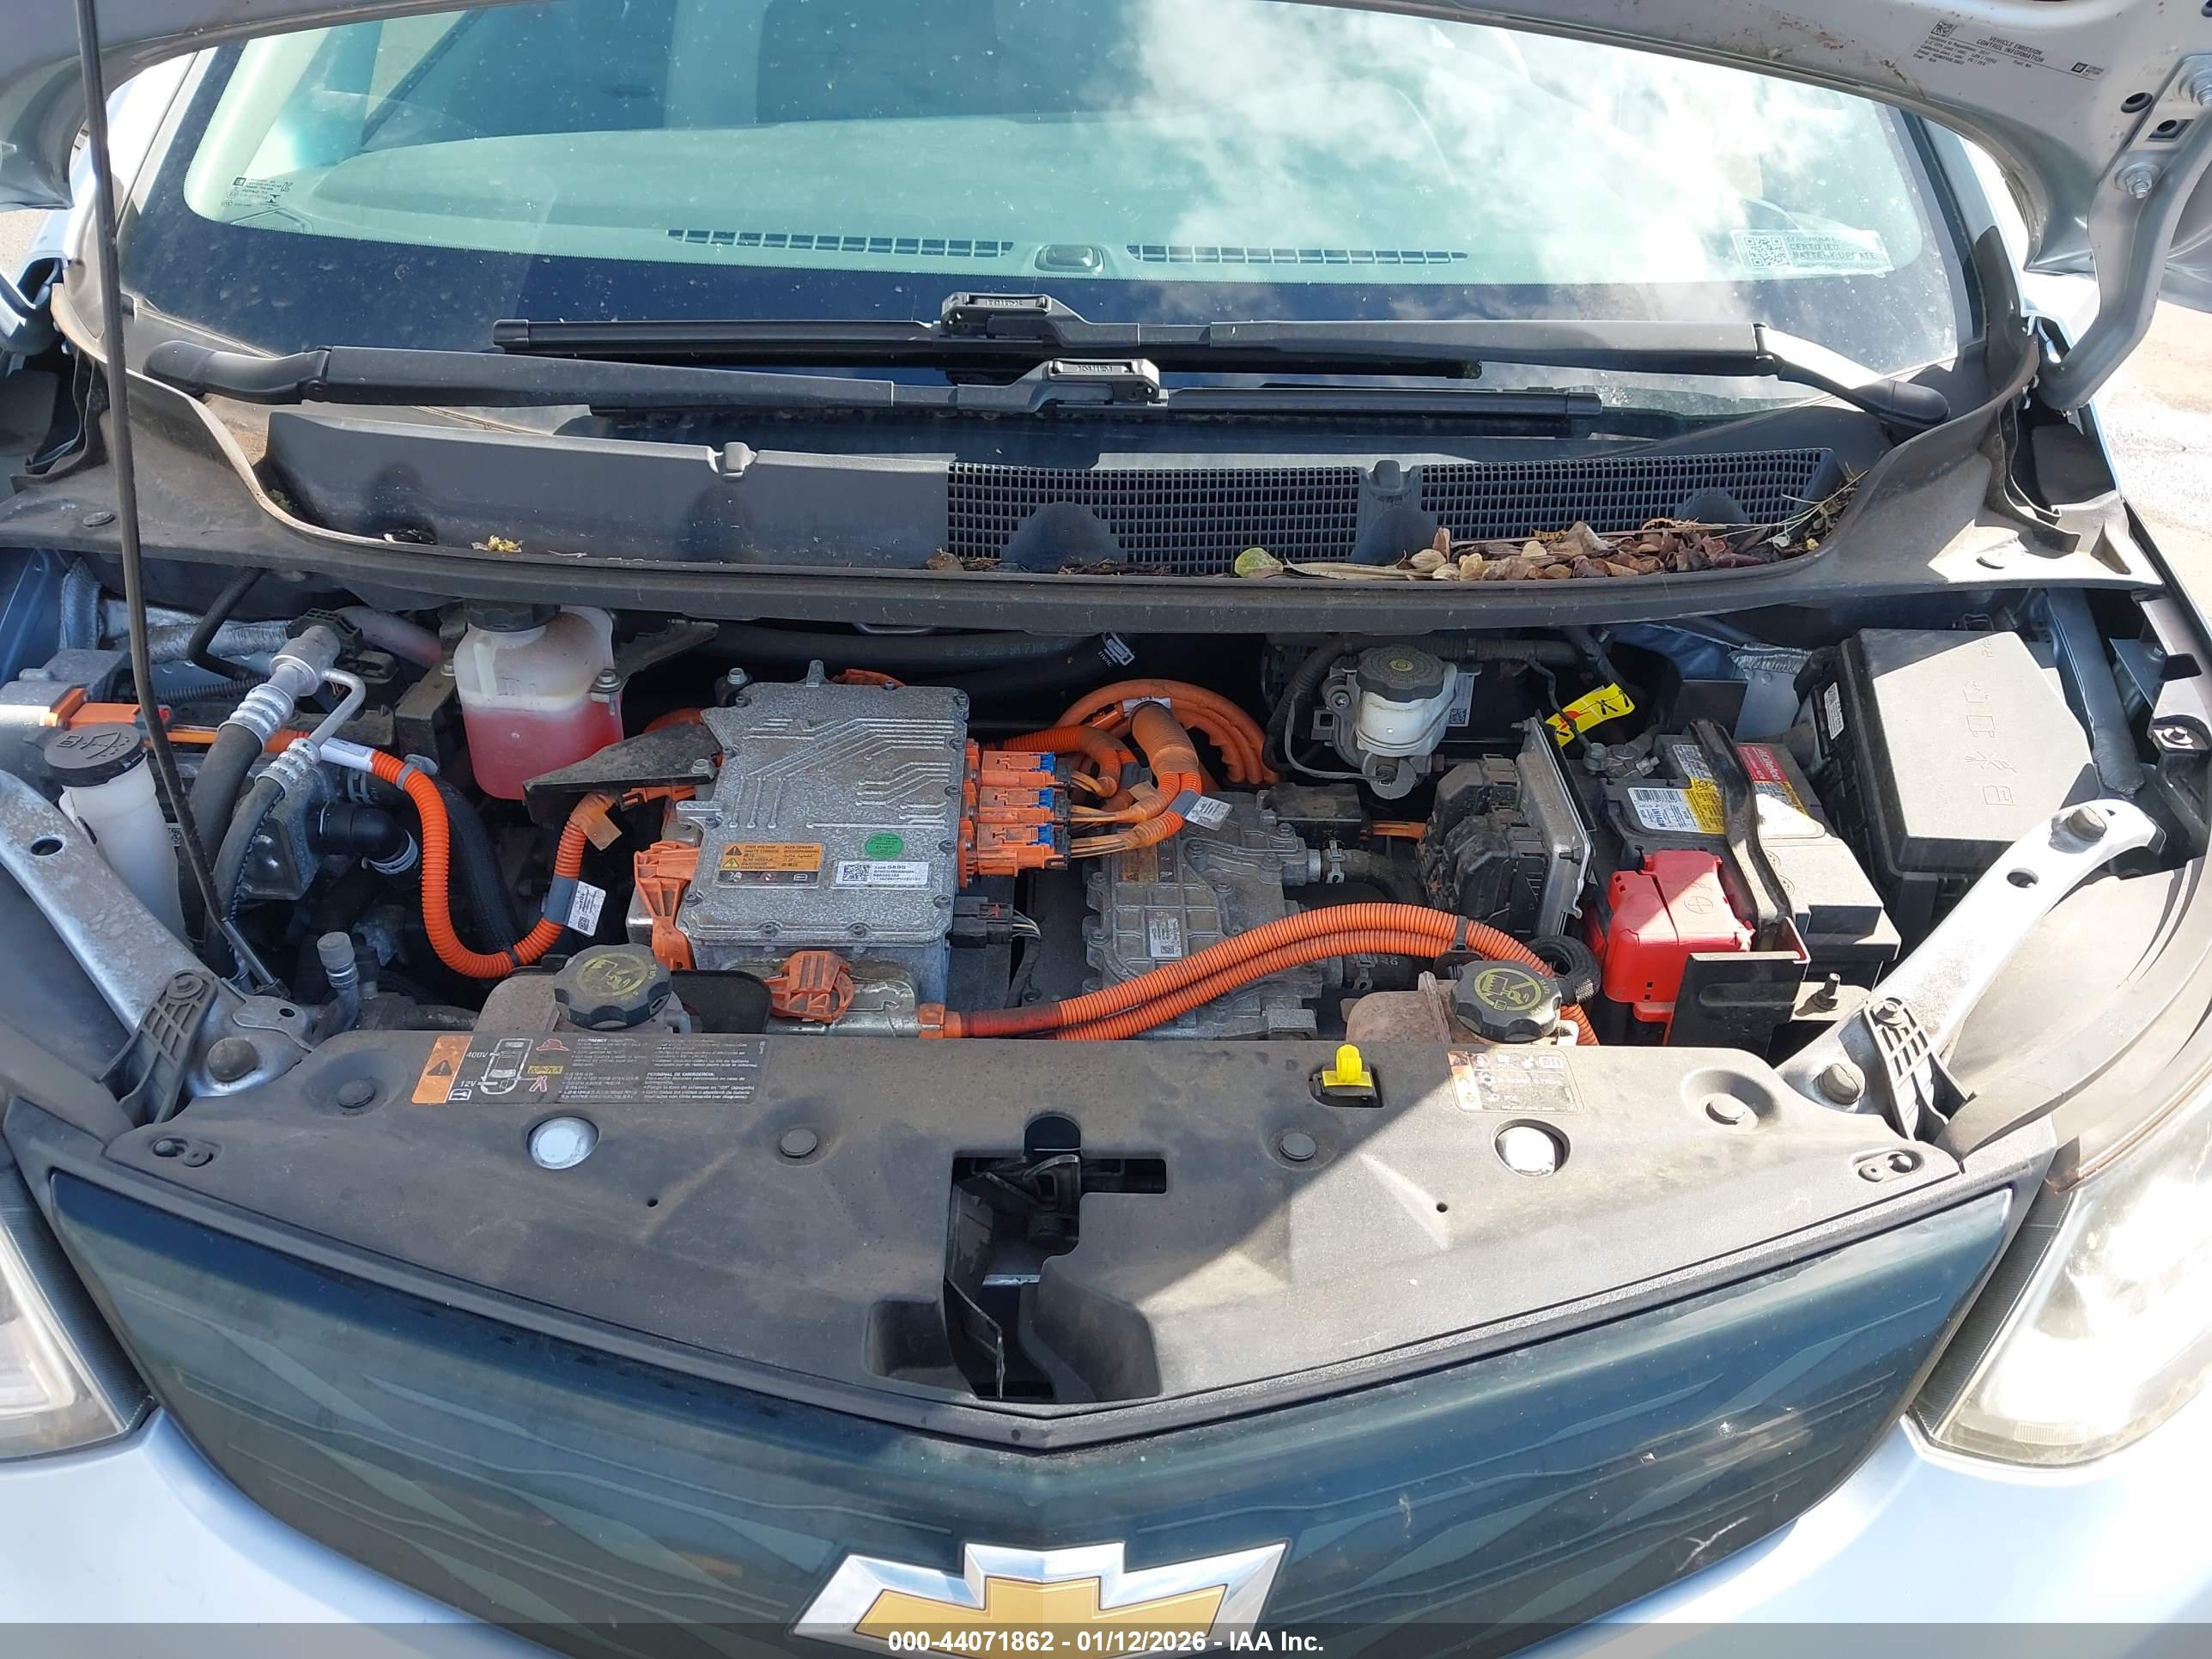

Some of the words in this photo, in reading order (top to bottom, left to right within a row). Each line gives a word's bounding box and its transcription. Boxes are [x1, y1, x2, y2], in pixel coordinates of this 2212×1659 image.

[1977, 39, 2003, 51] CONTROL
[2004, 46, 2045, 63] INFORMATION
[1990, 35, 2014, 47] VEHICLE
[2014, 41, 2043, 56] EMISSION
[1793, 252, 1834, 260] BATTERY
